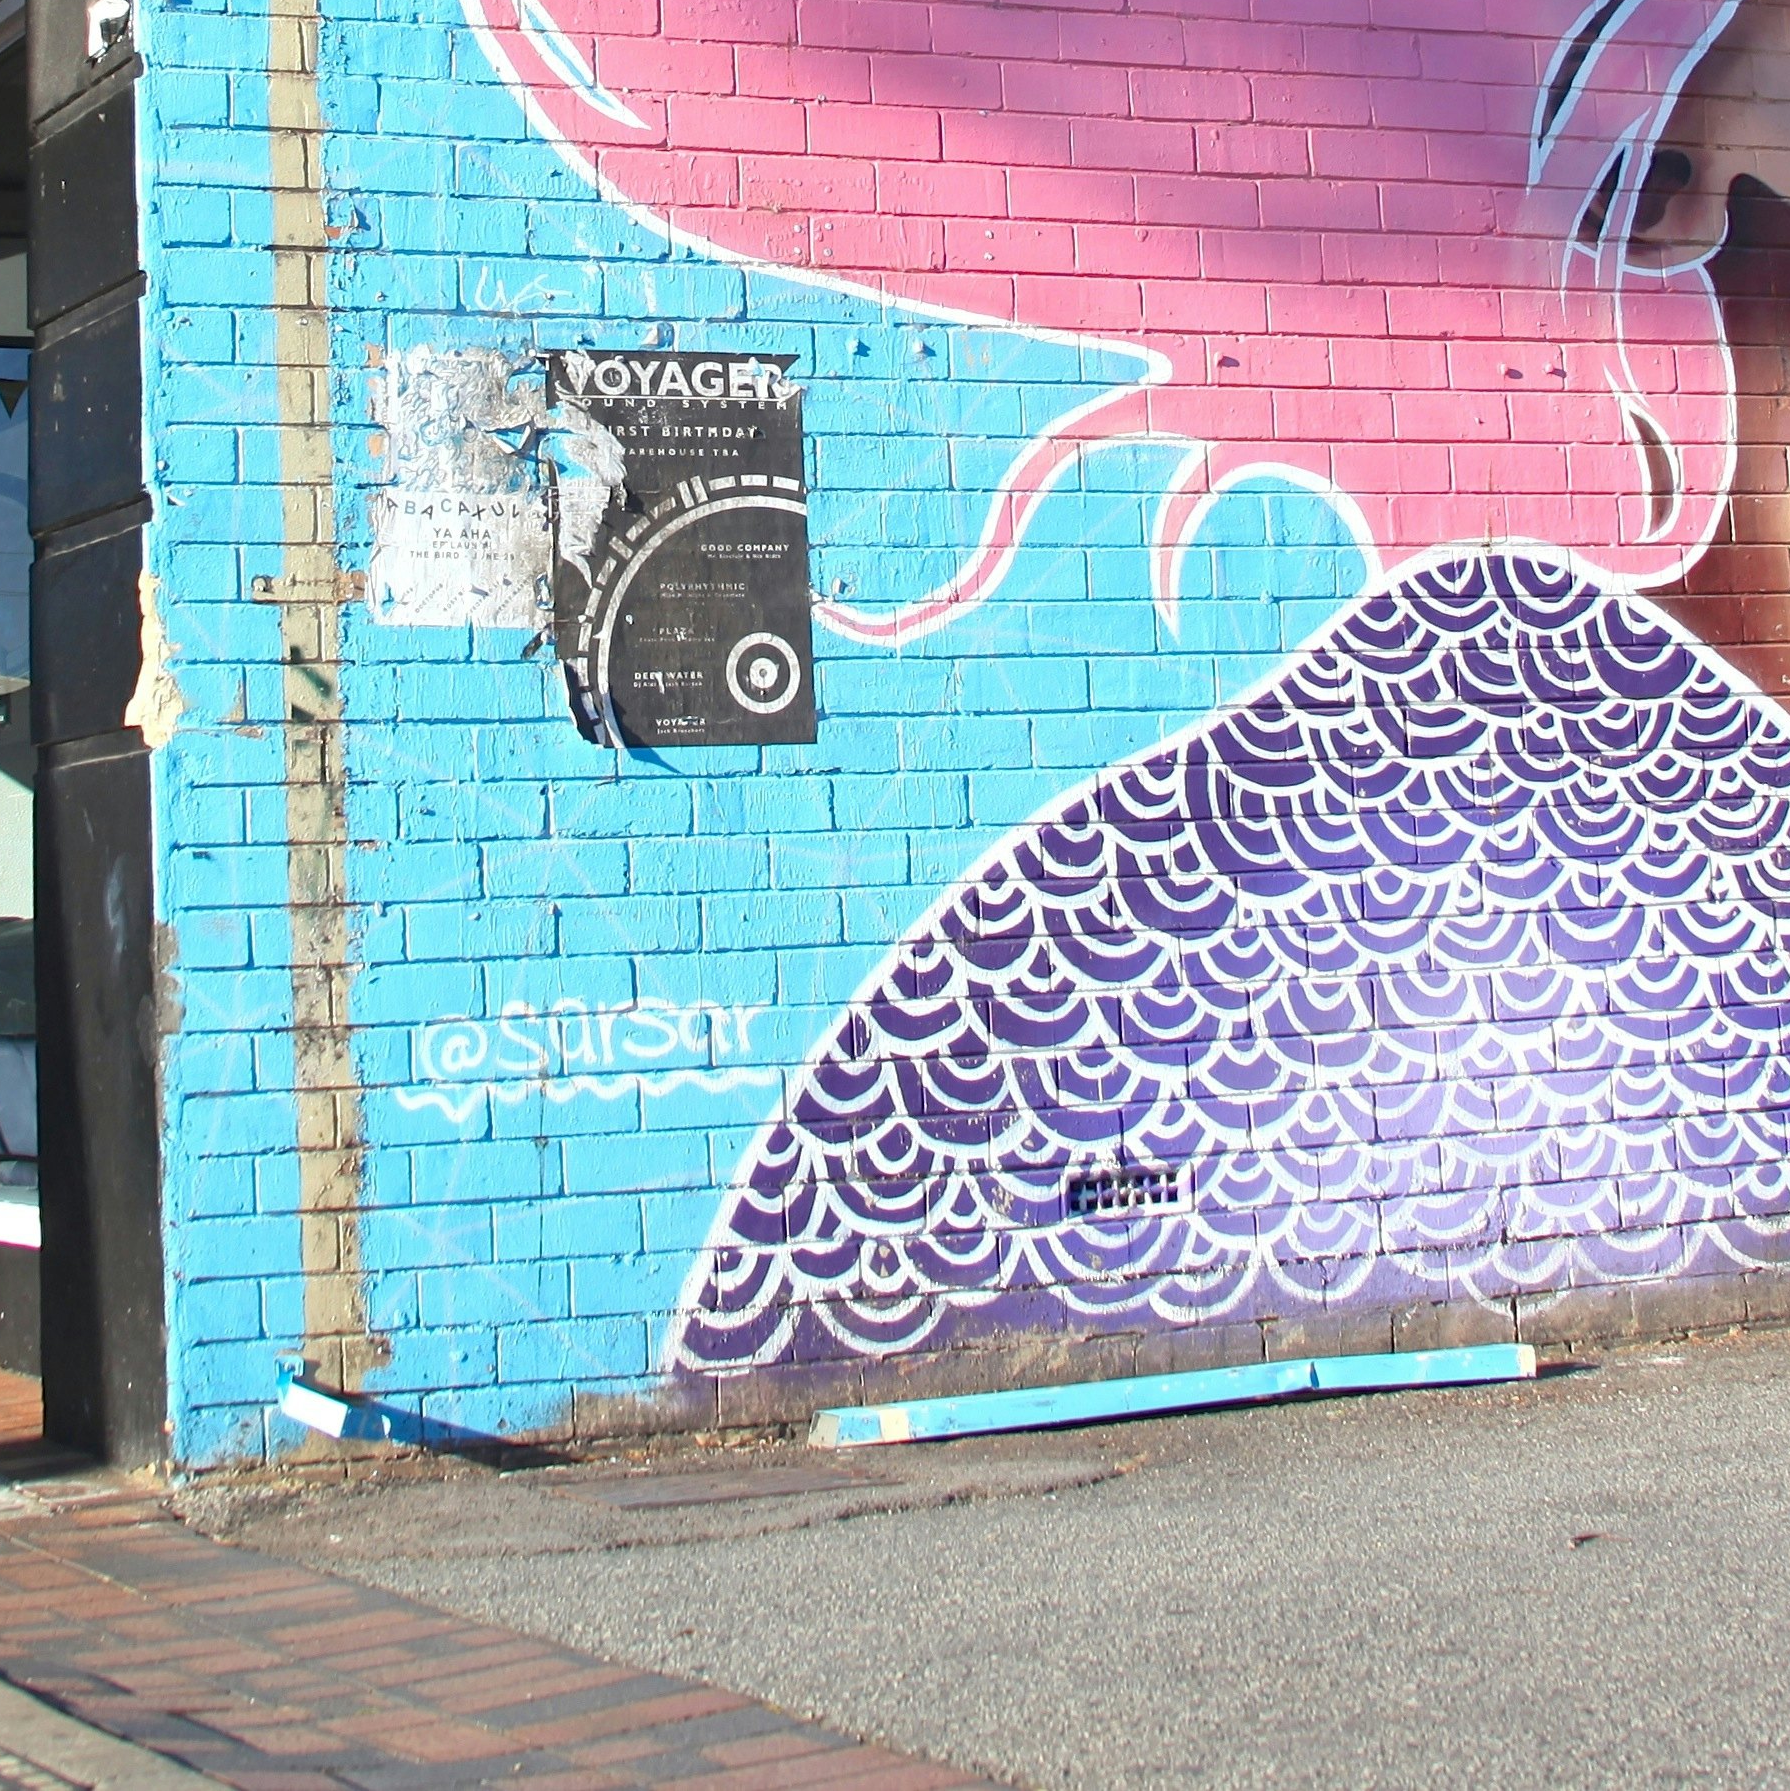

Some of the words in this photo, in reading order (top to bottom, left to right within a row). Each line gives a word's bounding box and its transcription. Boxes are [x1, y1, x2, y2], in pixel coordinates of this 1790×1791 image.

[581, 398, 656, 408] OUND
[681, 399, 788, 411] SYSTEM
[661, 425, 758, 439] BIRTHDAY
[712, 448, 740, 457] TBA
[432, 527, 453, 539] YA
[459, 527, 492, 540] AHA
[700, 543, 733, 552] GOOD
[737, 543, 791, 552] COMPANY
[410, 550, 430, 559] THE
[434, 551, 460, 560] BIRD
[634, 671, 664, 681] DEE
